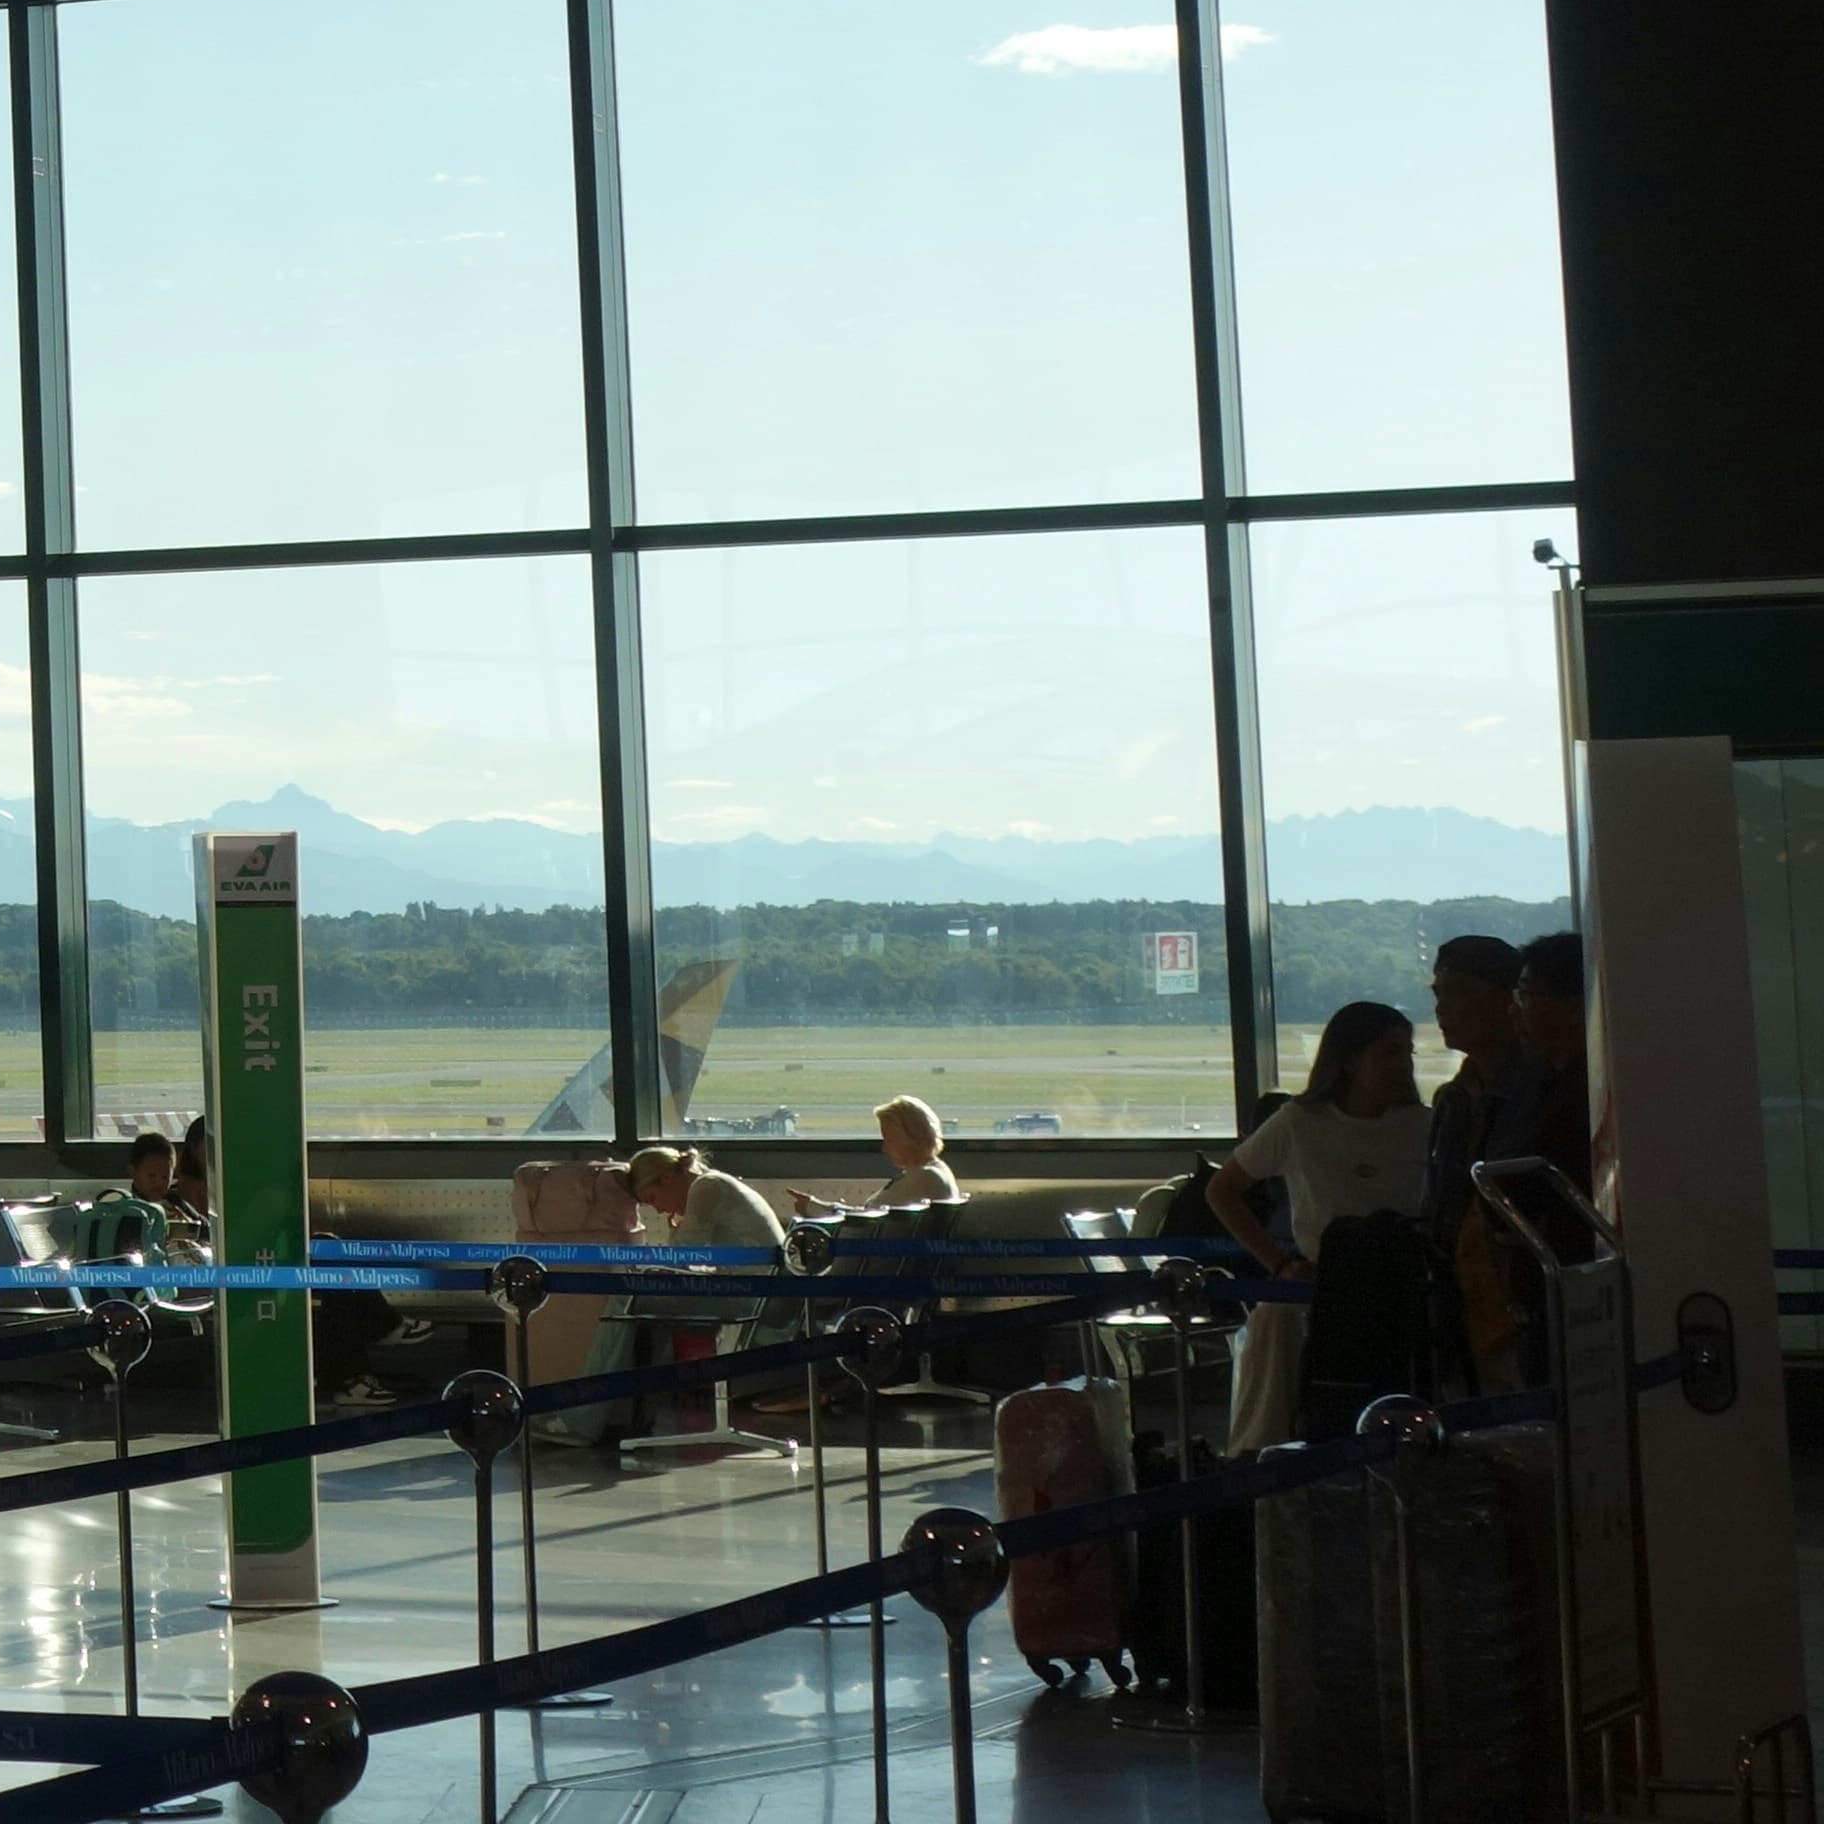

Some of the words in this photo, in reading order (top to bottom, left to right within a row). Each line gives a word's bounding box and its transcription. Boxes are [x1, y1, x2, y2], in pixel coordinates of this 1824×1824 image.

[242, 984, 281, 1072] Exit
[341, 1242, 383, 1257] Milano
[389, 1242, 451, 1261] Malpensa
[599, 1246, 643, 1261] Milano
[650, 1245, 713, 1265] Malpensa
[11, 1266, 57, 1284] Milano
[63, 1266, 131, 1289] Malpensa
[295, 1268, 343, 1285] Milano
[350, 1268, 420, 1289] Malpensa
